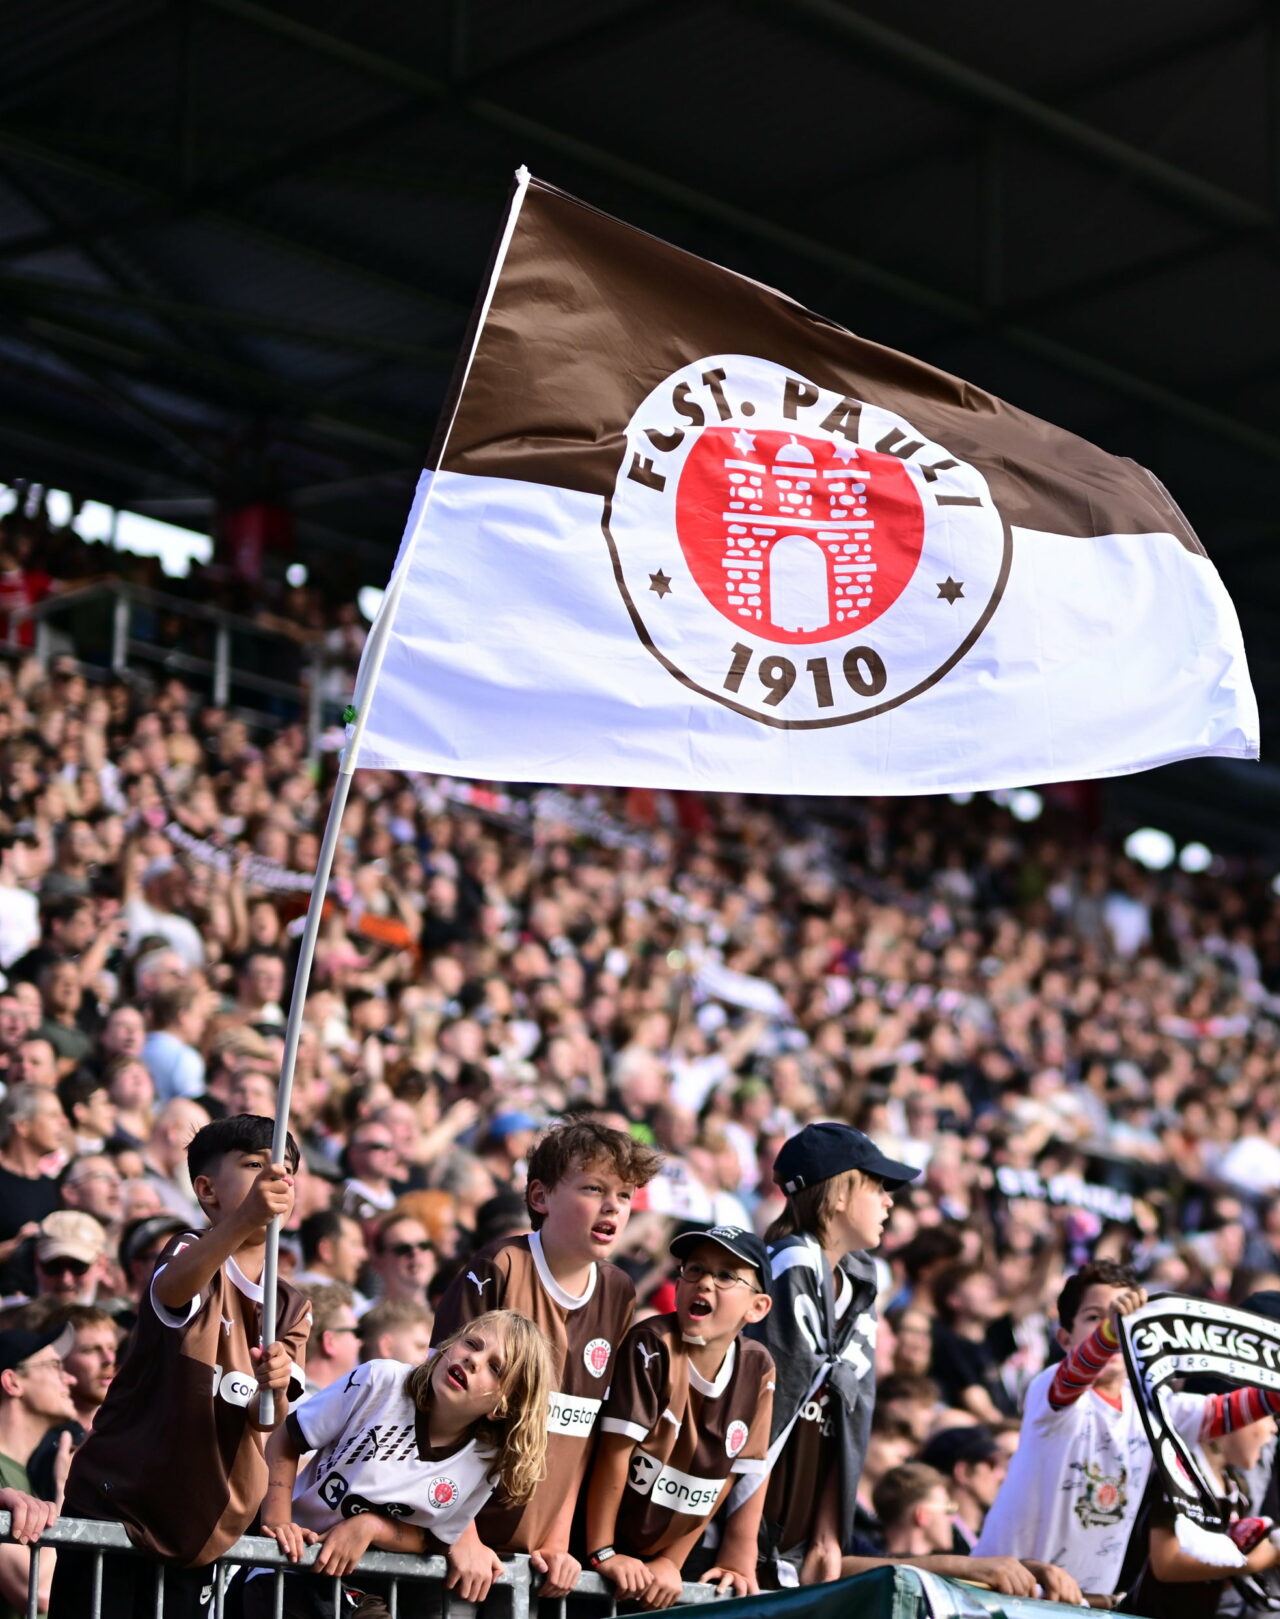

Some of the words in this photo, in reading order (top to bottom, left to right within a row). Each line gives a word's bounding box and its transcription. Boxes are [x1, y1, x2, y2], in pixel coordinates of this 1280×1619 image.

[627, 427, 685, 493] FC
[671, 366, 757, 427] ST.
[782, 375, 986, 508] PAULI
[722, 641, 888, 709] 1910
